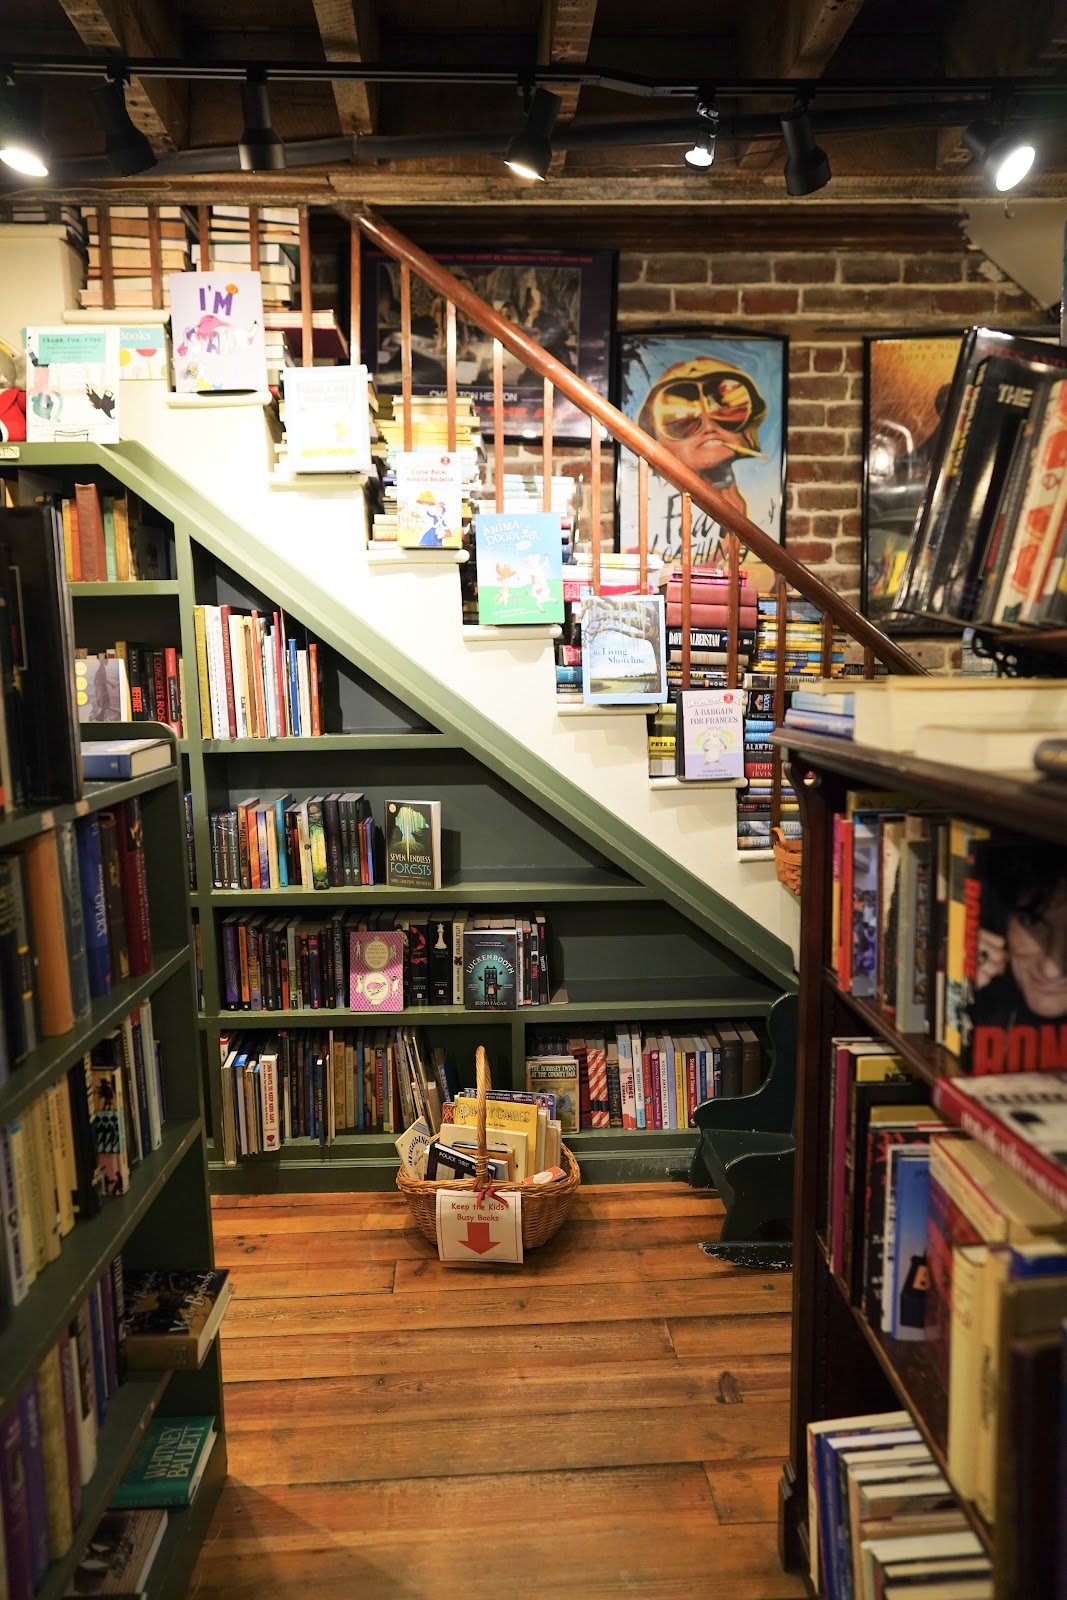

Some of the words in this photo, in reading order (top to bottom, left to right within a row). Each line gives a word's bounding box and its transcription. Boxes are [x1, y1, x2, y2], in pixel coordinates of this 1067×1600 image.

[199, 284, 233, 316] I'M
[429, 389, 479, 400] CHATON
[480, 391, 518, 401] HESON
[998, 383, 1034, 408] THE
[668, 631, 683, 645] DAVI
[689, 633, 720, 647] ALBERSTAM
[602, 647, 628, 657] Living
[608, 656, 646, 664] Shoreline
[154, 657, 164, 699] CONCRETE
[131, 686, 143, 713] REFUGEE
[763, 693, 771, 712] TEXAS
[156, 700, 166, 722] ROS
[701, 707, 734, 715] BARGAIN
[705, 716, 739, 724] FRANCES
[746, 743, 764, 751] ALAN
[239, 829, 247, 845] KILL
[240, 845, 248, 868] ORDER
[390, 853, 406, 862] SEVEN
[409, 854, 431, 864] ENDLESS
[390, 862, 432, 876] FORESTS
[93, 893, 106, 938] OPERA
[138, 897, 147, 941] SCHULLER
[466, 954, 515, 974] LUCKENBOOTH
[459, 1103, 495, 1125] PAY
[496, 1107, 530, 1123] GAMES
[438, 1152, 456, 1163] POLICE
[451, 1202, 470, 1211] Keep
[473, 1202, 486, 1211] the
[488, 1202, 505, 1211] Kids
[457, 1214, 475, 1223] Busy
[477, 1214, 499, 1222] Books
[143, 1426, 185, 1480] WHITNEY
